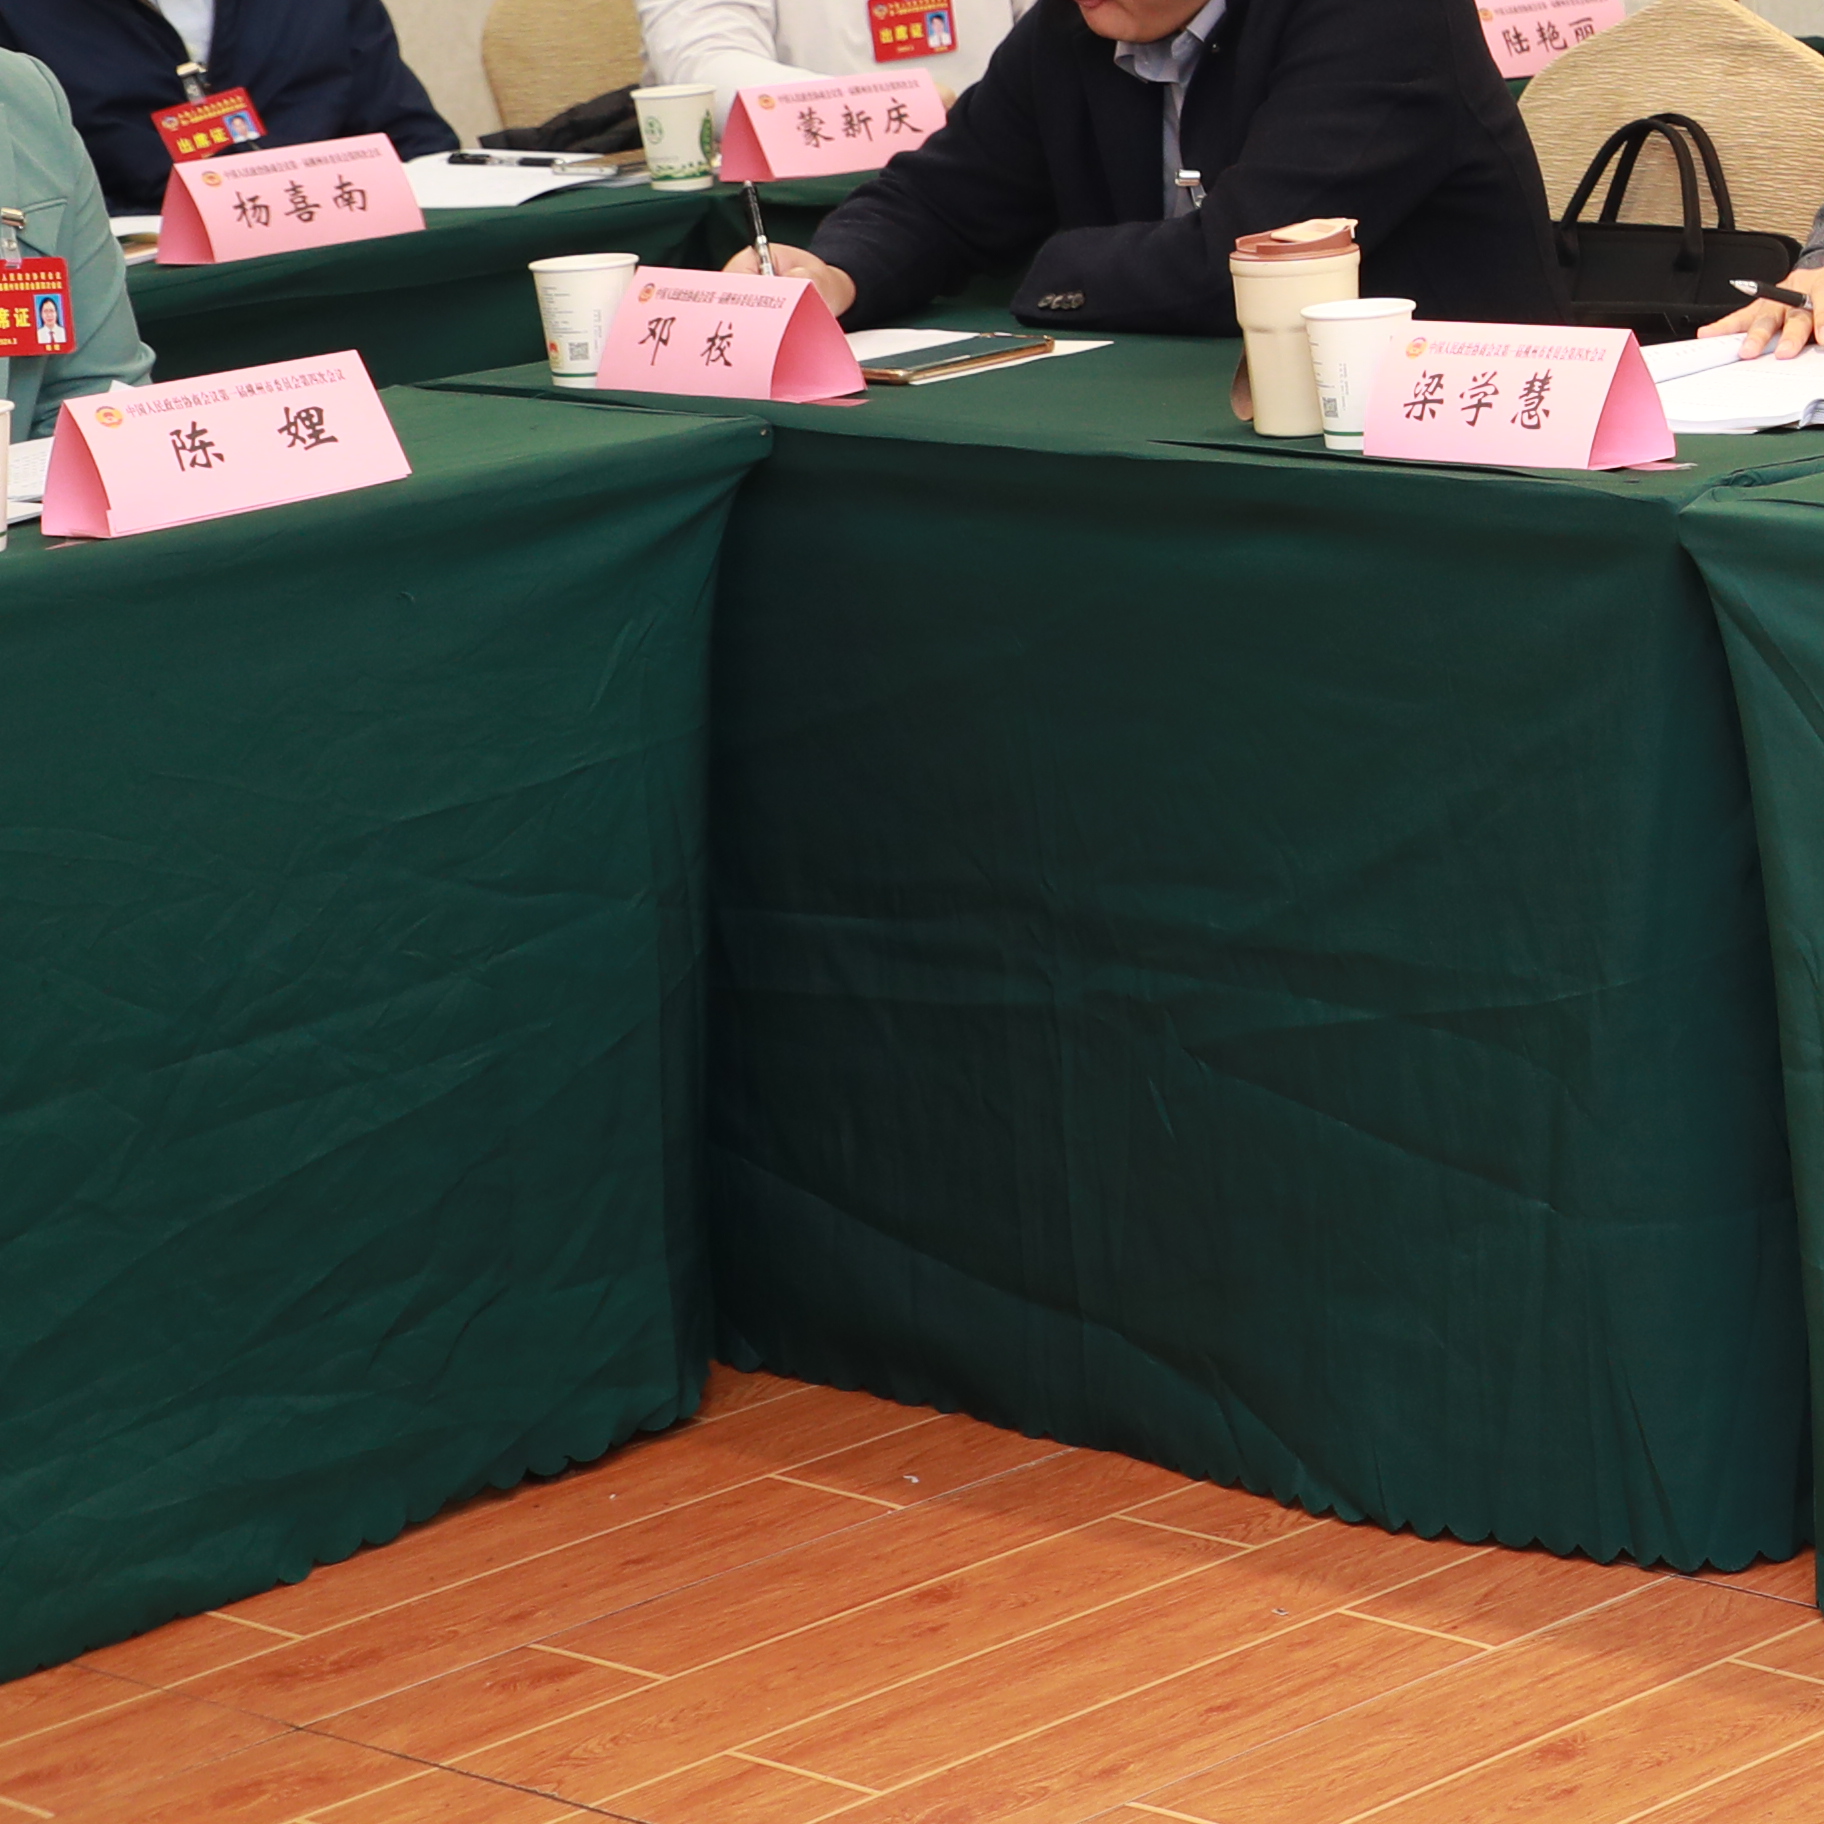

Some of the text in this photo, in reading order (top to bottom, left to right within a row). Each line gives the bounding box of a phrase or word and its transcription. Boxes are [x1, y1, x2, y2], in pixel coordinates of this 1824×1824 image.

[1502, 17, 1595, 57] 陆艳丽
[177, 127, 229, 154] 出席证
[797, 97, 923, 149] 蒙新庆
[233, 175, 367, 229] 杨喜南
[638, 317, 733, 367] 邓校
[1403, 368, 1553, 429] 梁学慧
